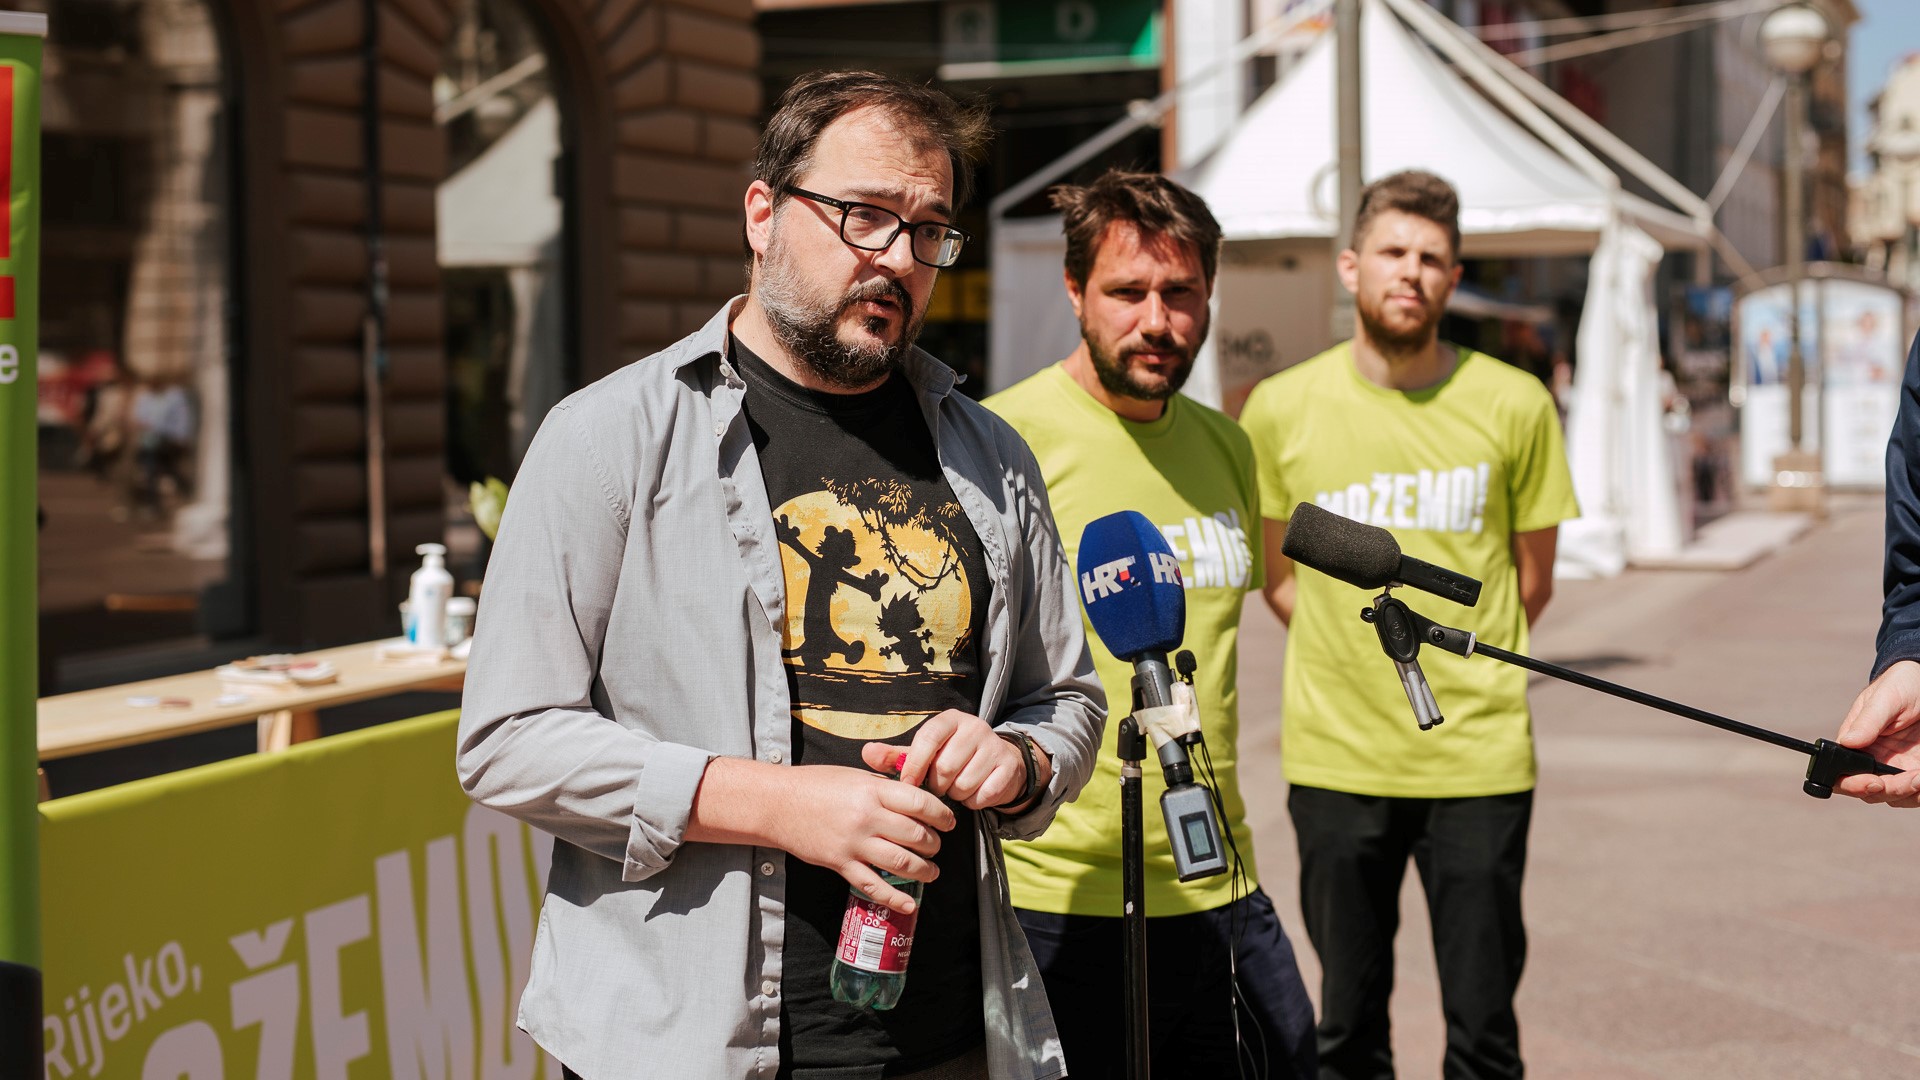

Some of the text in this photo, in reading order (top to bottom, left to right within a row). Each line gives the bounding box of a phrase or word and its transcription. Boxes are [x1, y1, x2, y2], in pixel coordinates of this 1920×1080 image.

[1081, 555, 1136, 604] HRT
[1148, 552, 1181, 586] HR
[1162, 507, 1252, 590] EMO!
[142, 802, 562, 1080] ŽEMO
[43, 940, 201, 1080] Rijeko,
